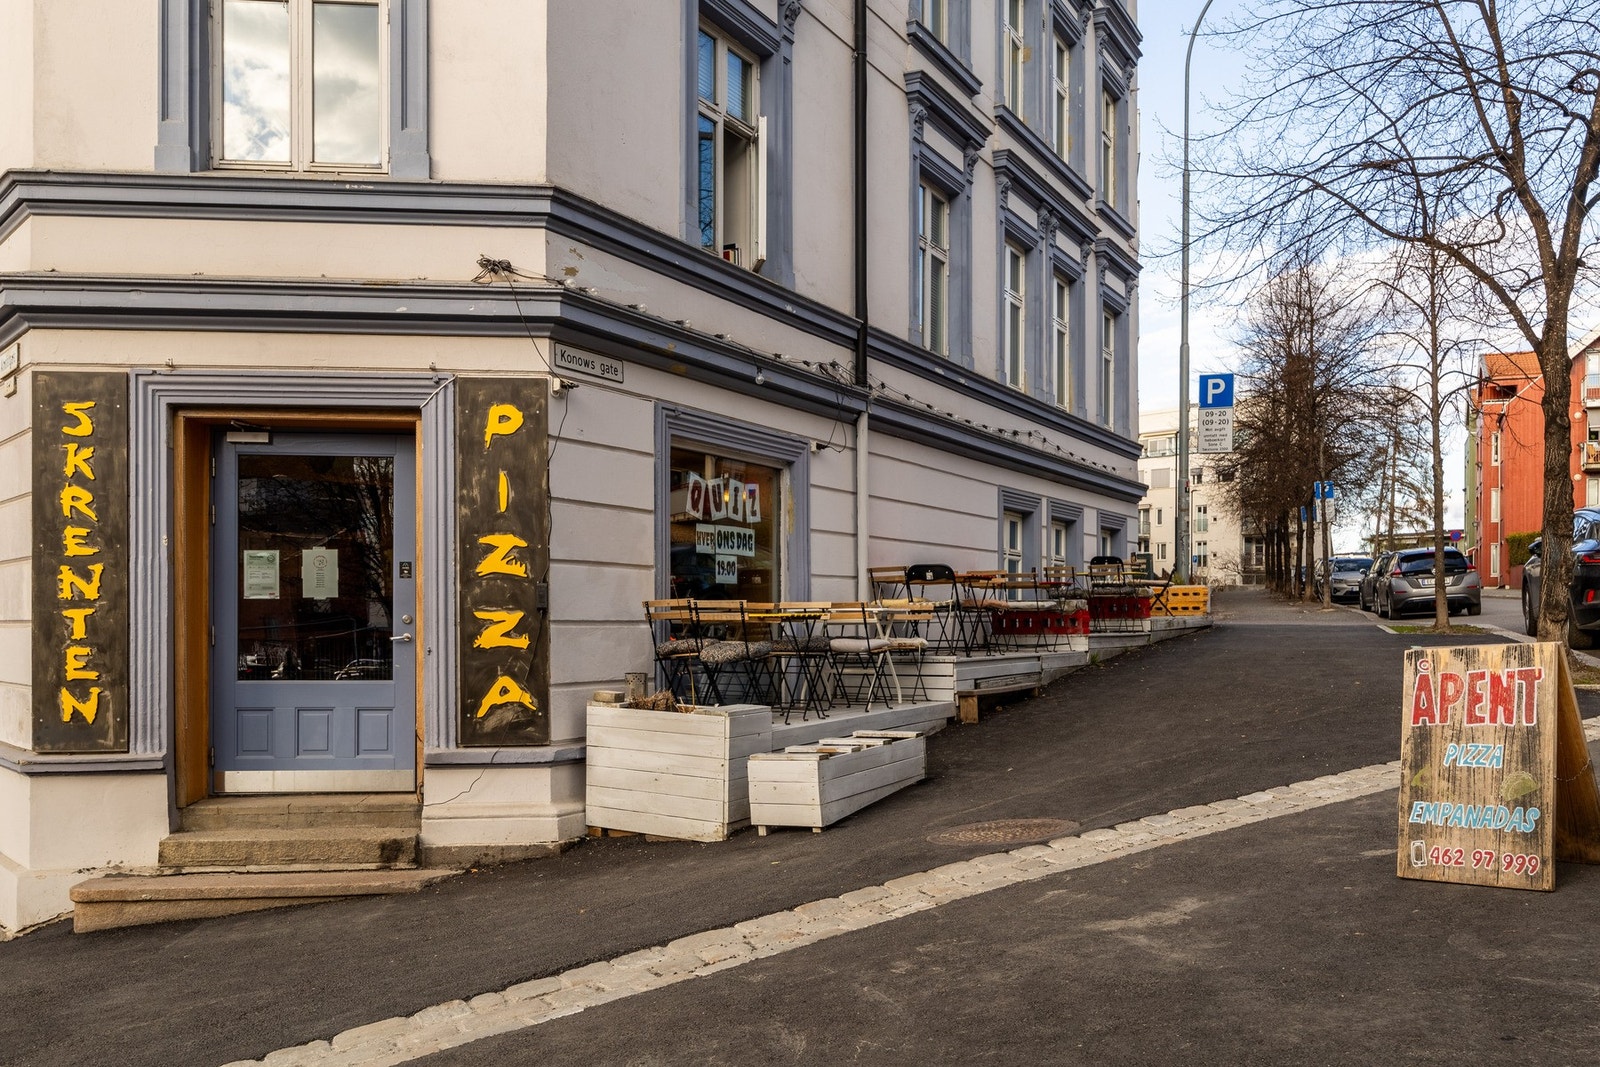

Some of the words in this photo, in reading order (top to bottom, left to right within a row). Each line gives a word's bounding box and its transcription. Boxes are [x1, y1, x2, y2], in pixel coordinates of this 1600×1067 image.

[560, 349, 595, 370] Konows
[600, 362, 619, 376] gate
[1207, 378, 1226, 405] P
[1205, 410, 1227, 418] 09-20
[690, 479, 757, 517] QUIZ
[696, 530, 715, 547] HVER
[57, 400, 105, 726] SKRENTEN
[472, 402, 538, 719] PIZZA
[1411, 658, 1545, 727] ÅPENT
[1443, 743, 1504, 768] PIZZA
[1409, 801, 1541, 833] EMPANADAS
[1429, 846, 1466, 866] 462
[1471, 849, 1495, 869] 97
[1502, 853, 1541, 876] 999
